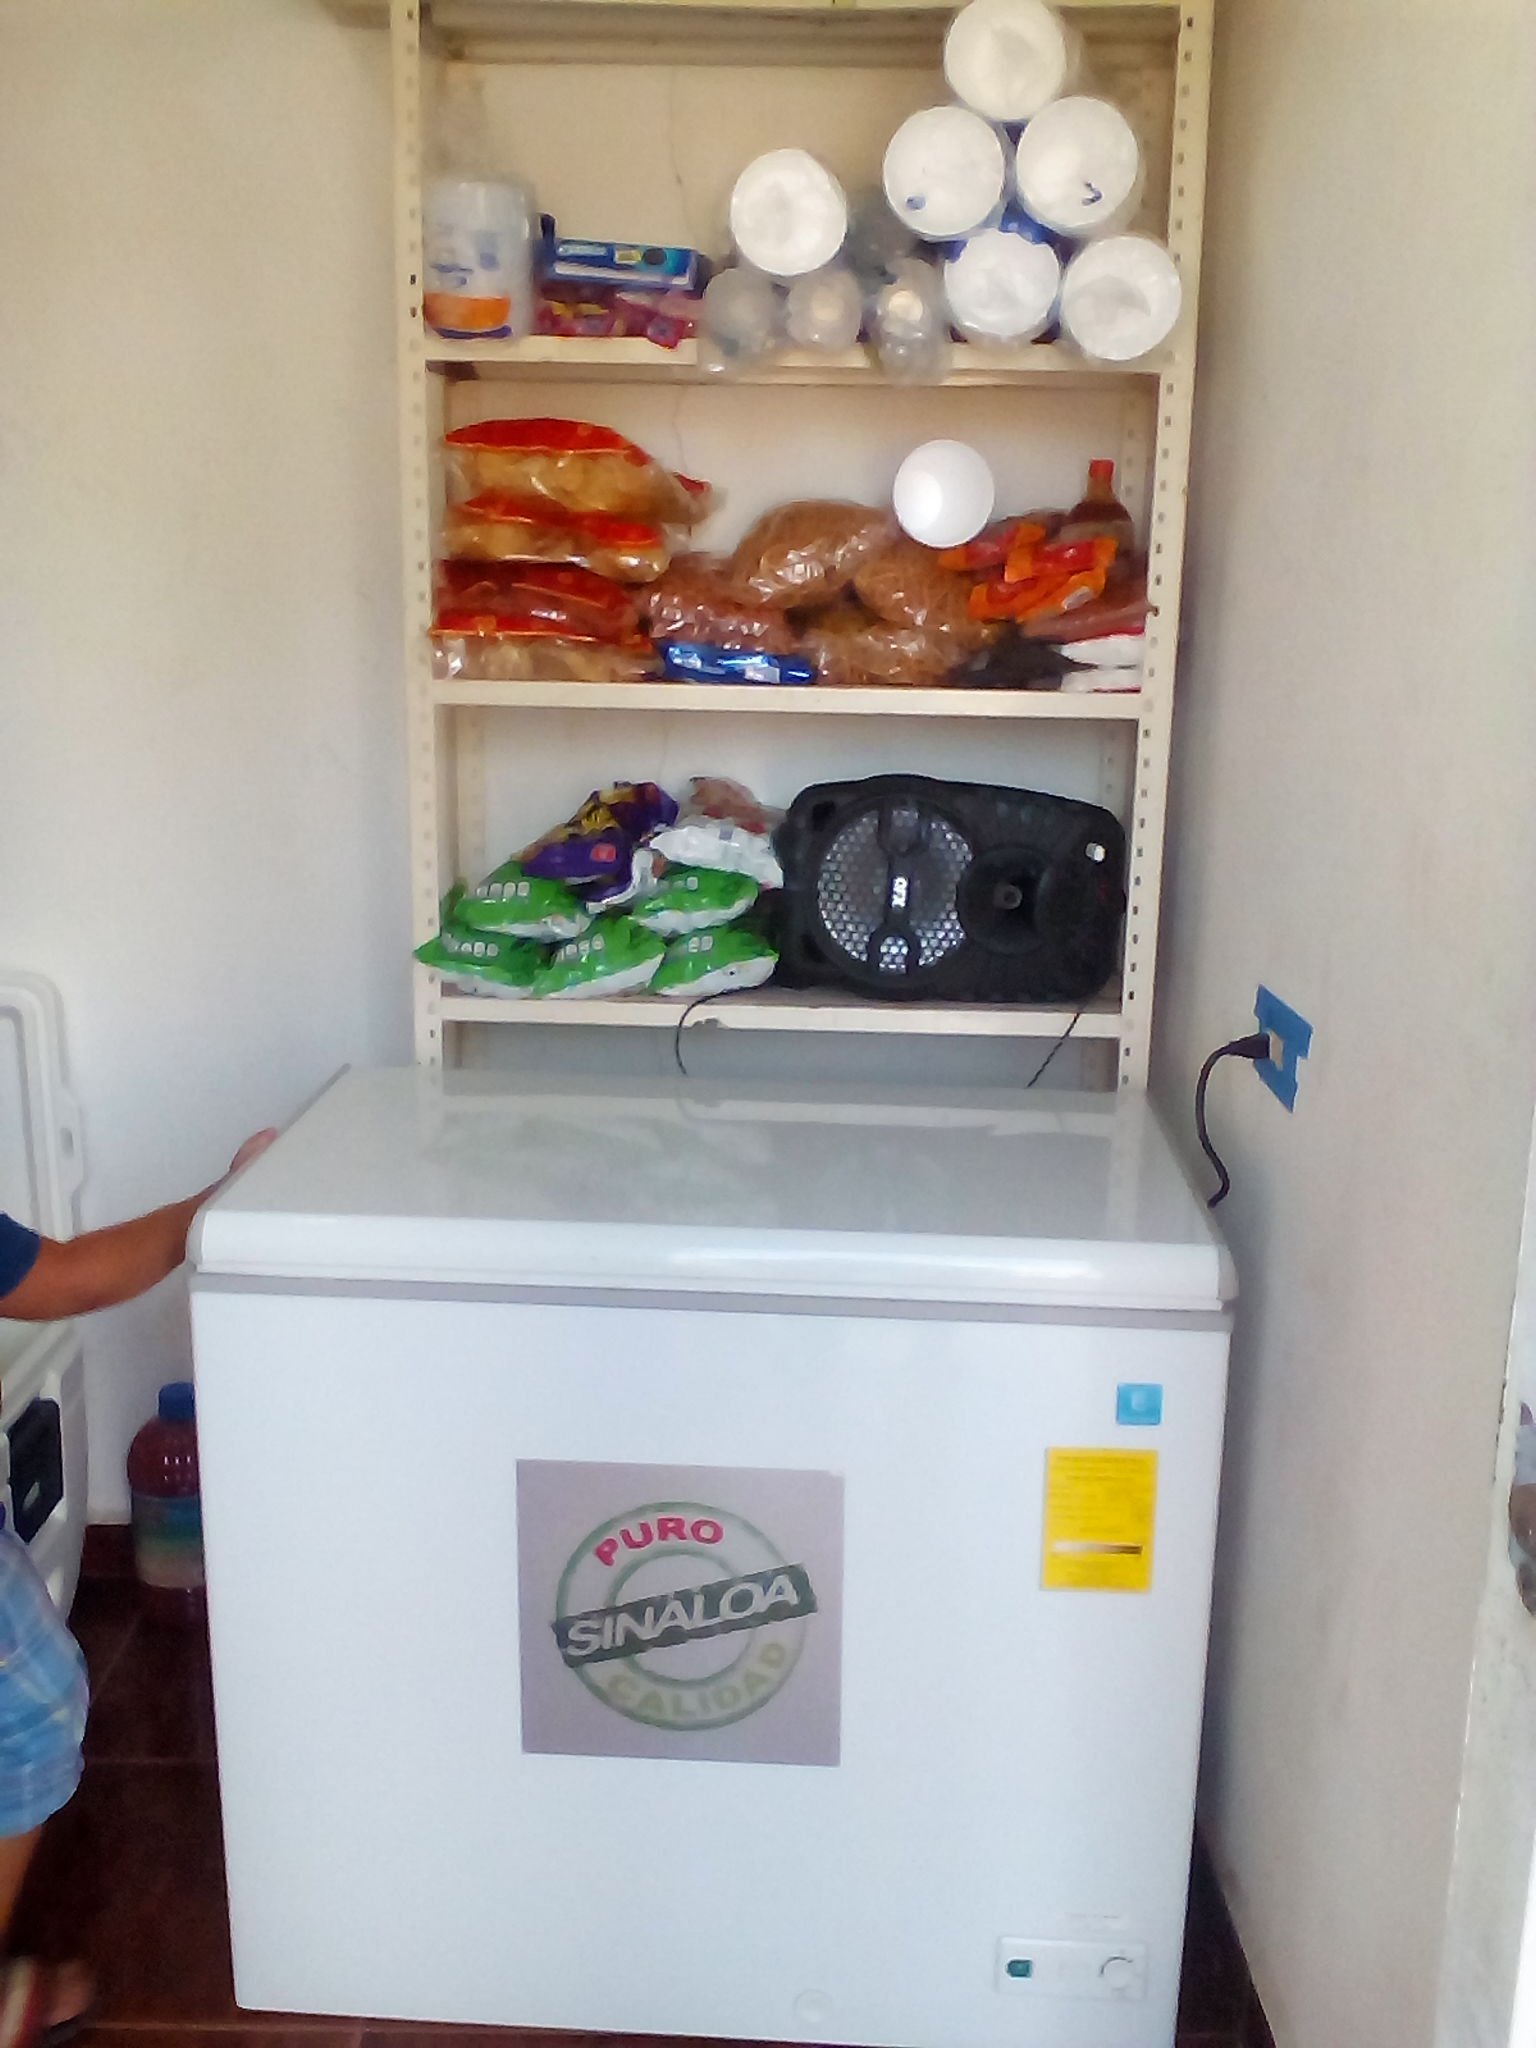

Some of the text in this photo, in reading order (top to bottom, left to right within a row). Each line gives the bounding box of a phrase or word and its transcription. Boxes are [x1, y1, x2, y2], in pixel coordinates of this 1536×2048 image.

[594, 1516, 724, 1566] PURO
[567, 1573, 799, 1656] SINALOA
[608, 1643, 786, 1718] CALIDAD
